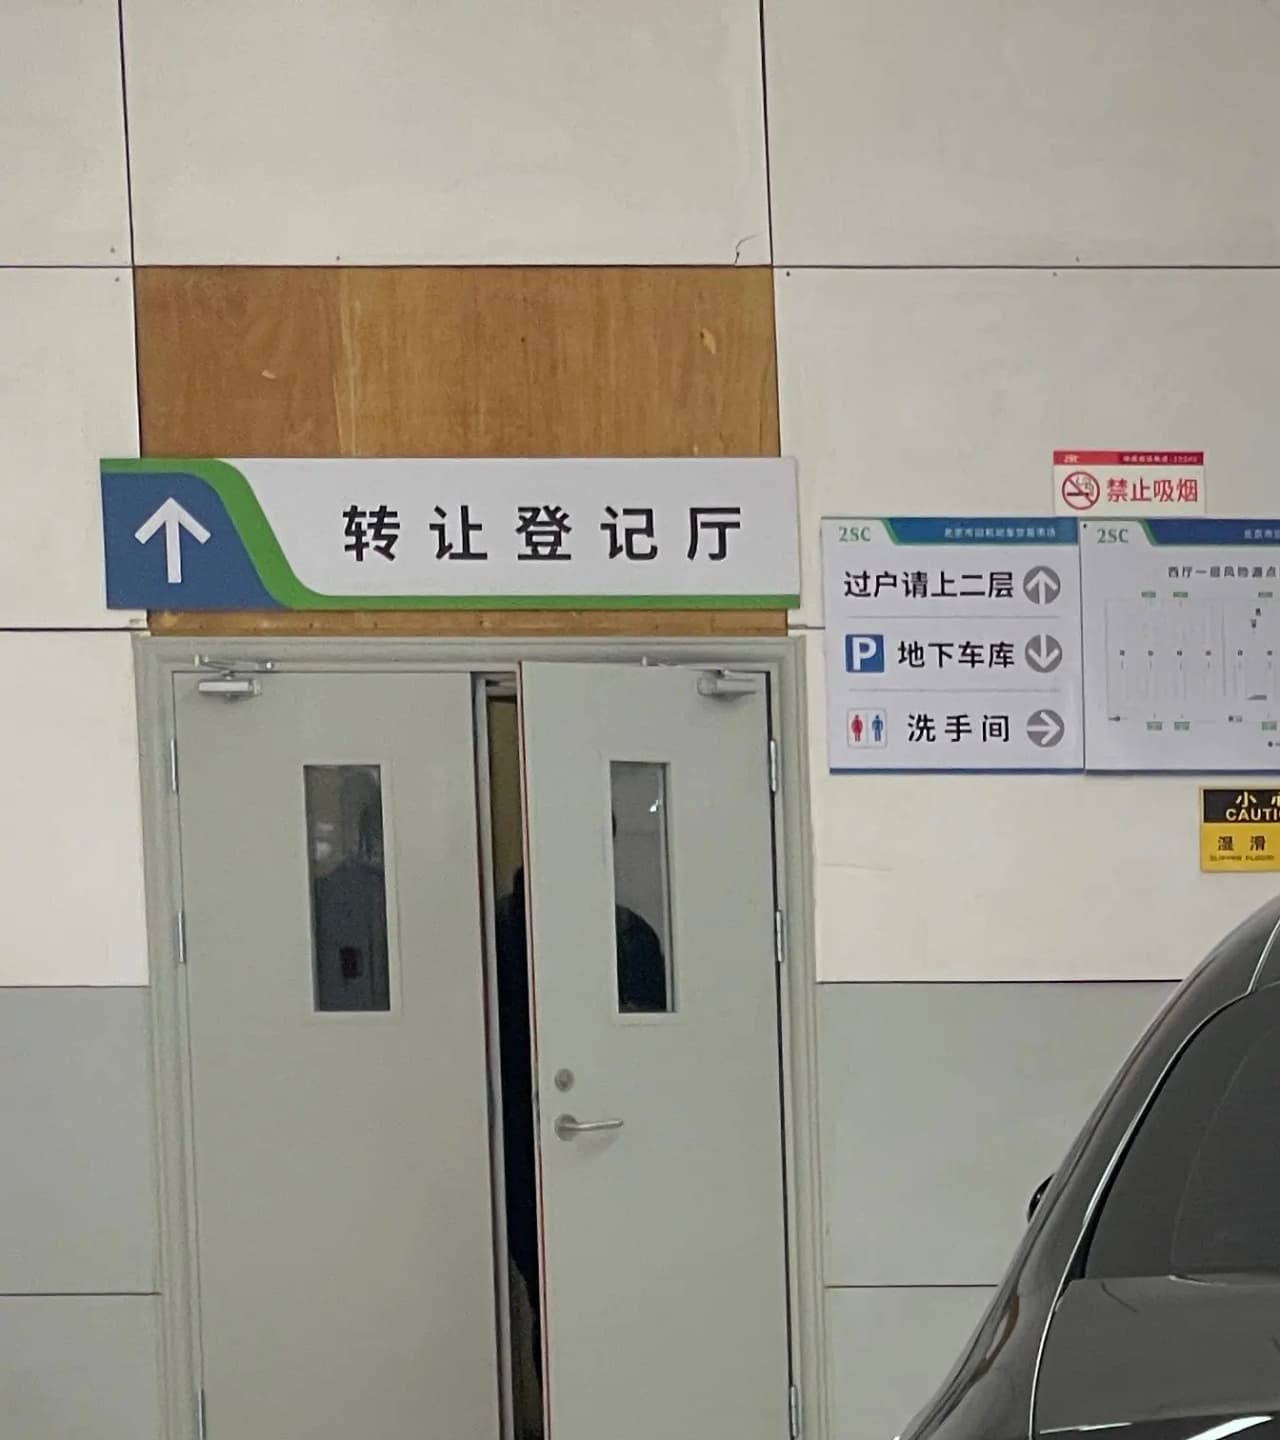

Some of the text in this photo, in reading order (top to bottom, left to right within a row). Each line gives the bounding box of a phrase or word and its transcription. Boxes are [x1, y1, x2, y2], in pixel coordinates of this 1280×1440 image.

[1107, 477, 1198, 503] 禁止吸烟
[343, 504, 741, 562] 转让登记厅
[838, 526, 872, 543] 2SC
[1096, 527, 1130, 544] 2SC
[843, 570, 1015, 599] 过户请上二层
[852, 636, 877, 671] P
[897, 640, 1015, 669] 地下车库
[907, 713, 1010, 743] 洗手间
[1217, 835, 1266, 851] 湿滑
